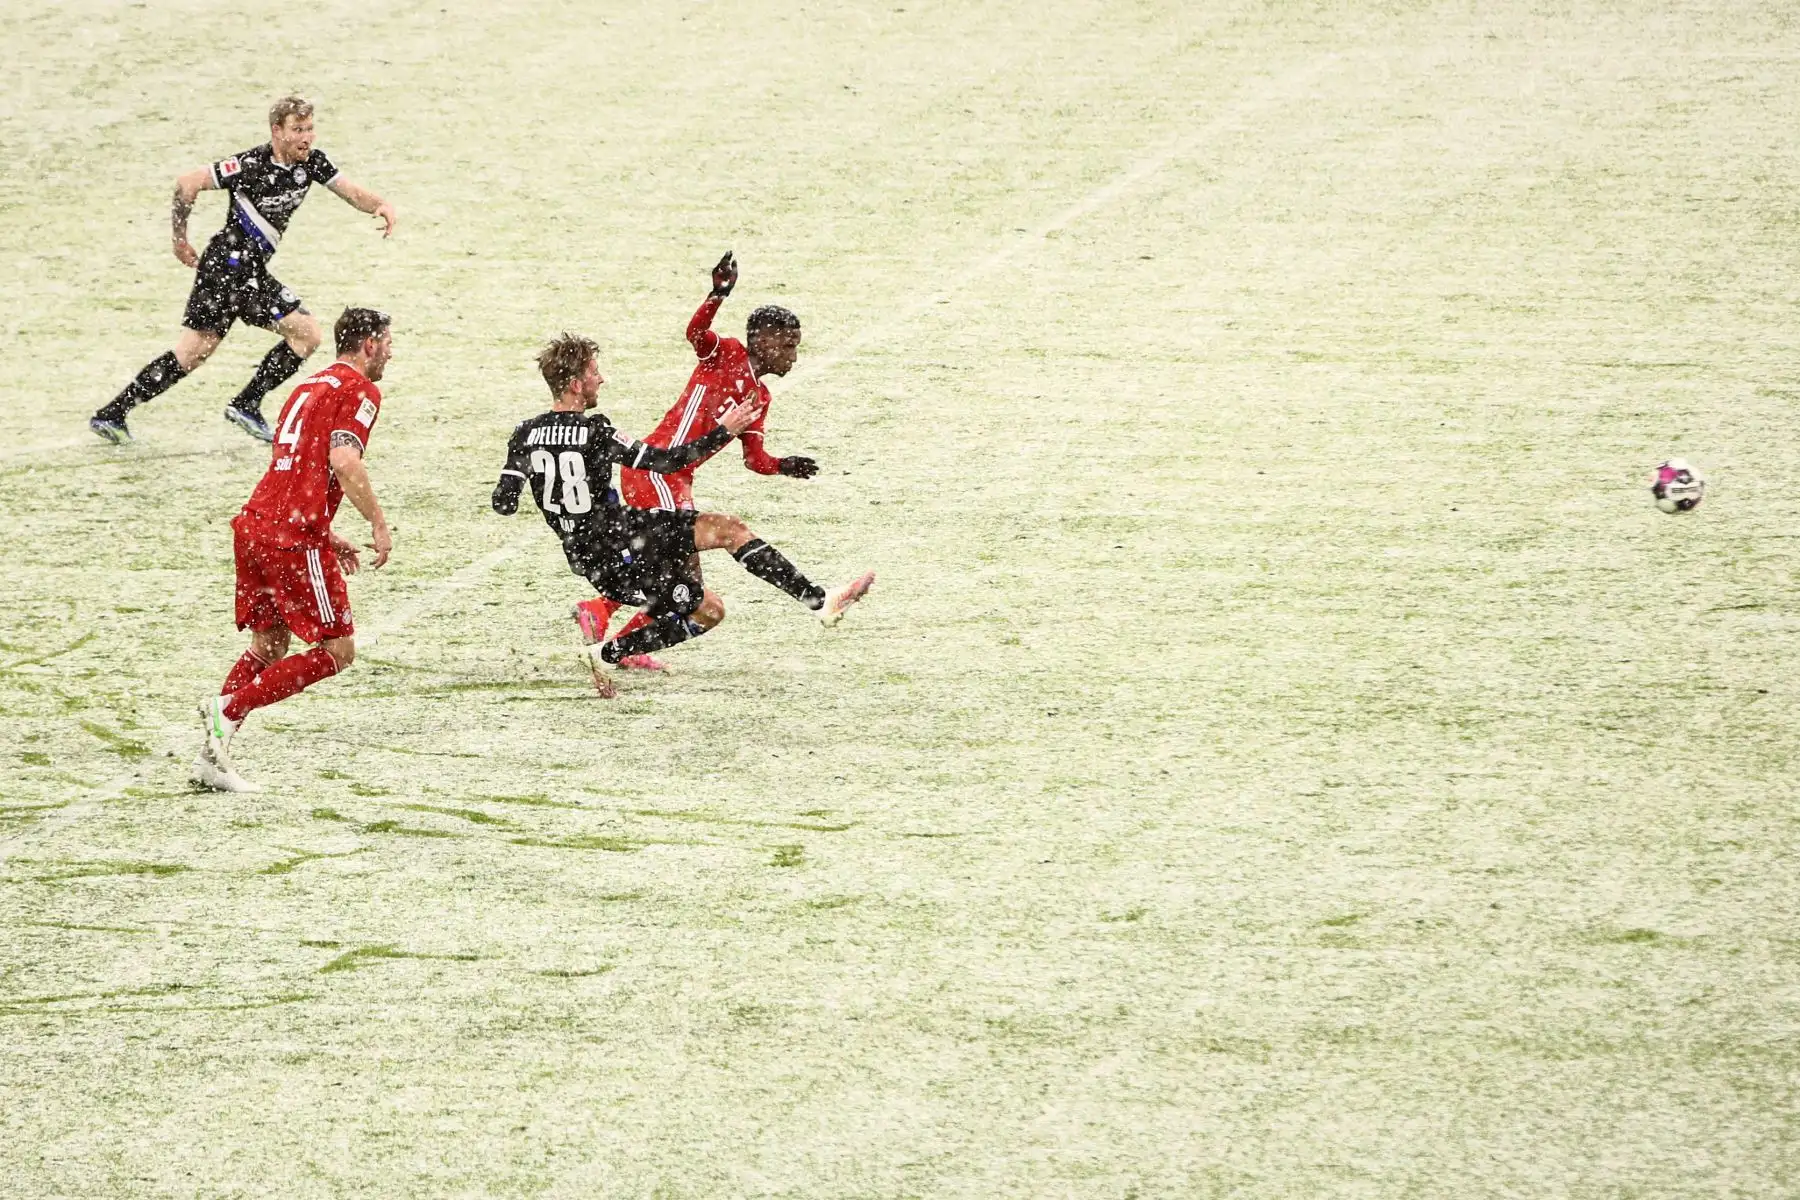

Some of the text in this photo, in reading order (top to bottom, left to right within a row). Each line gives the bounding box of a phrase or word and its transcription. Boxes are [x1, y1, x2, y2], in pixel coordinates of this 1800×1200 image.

[278, 391, 311, 454] 4
[527, 425, 589, 446] BIELEFELD
[530, 449, 592, 515] 28
